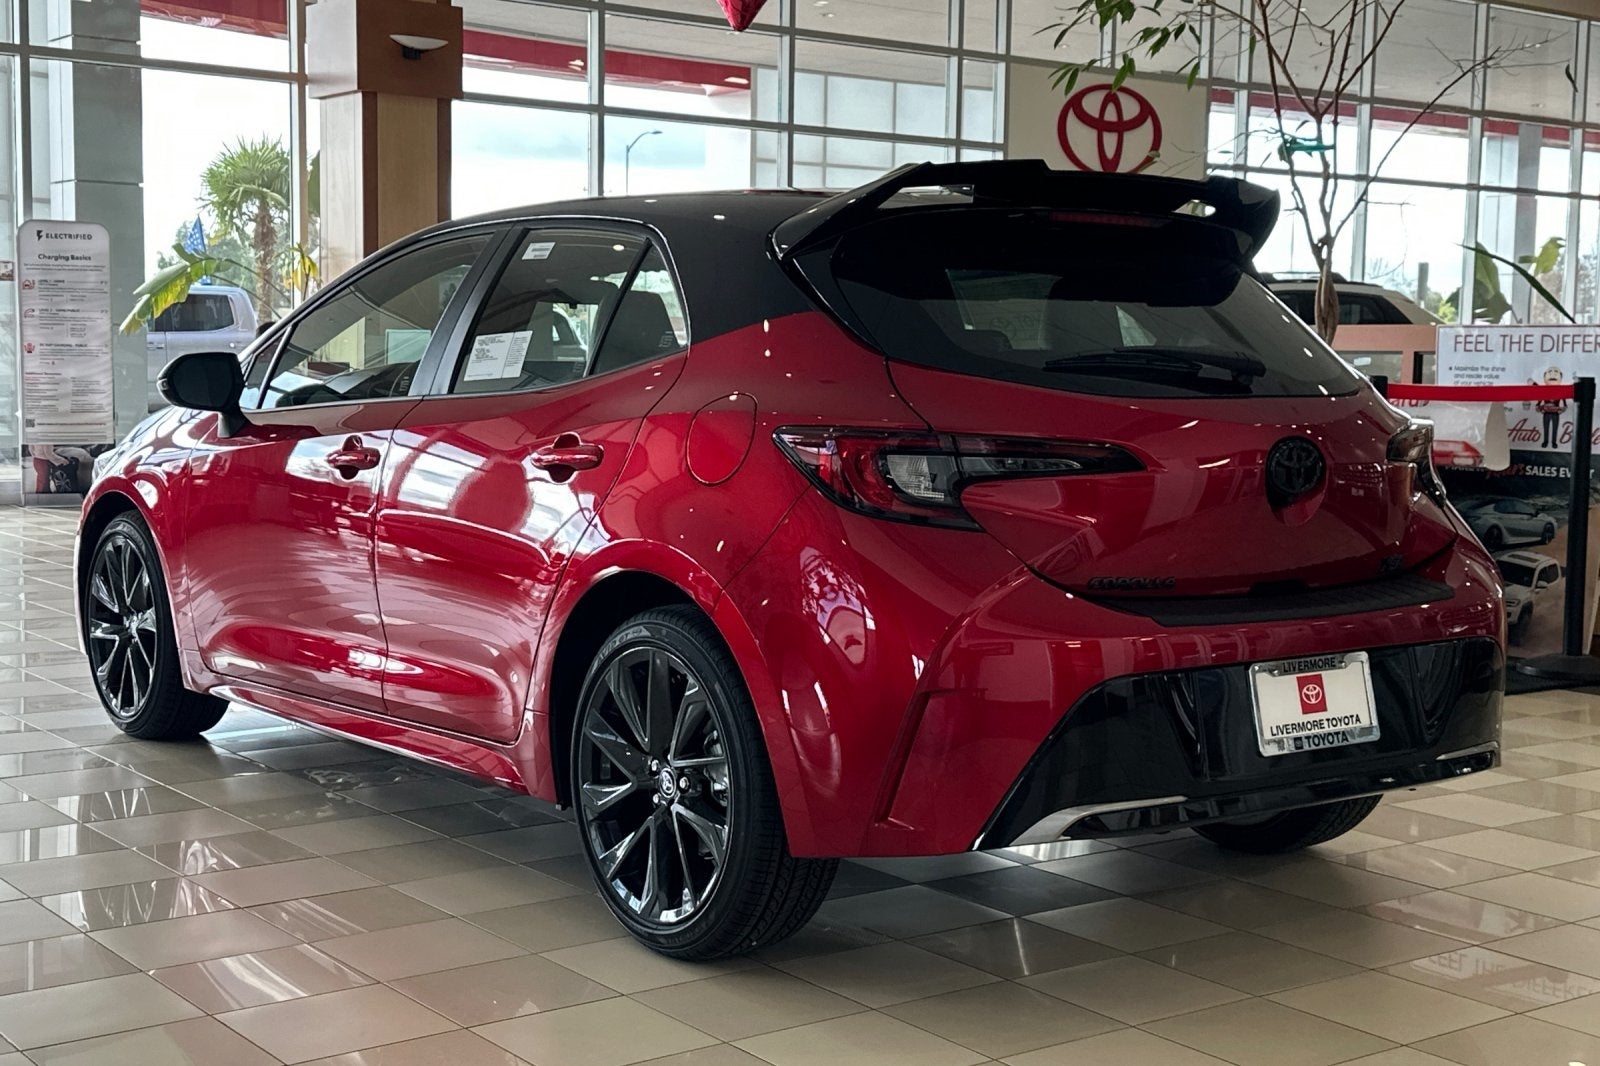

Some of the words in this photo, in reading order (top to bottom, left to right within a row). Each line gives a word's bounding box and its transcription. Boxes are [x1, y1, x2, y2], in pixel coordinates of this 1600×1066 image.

[45, 232, 93, 240] ELECTRIFIED
[38, 253, 70, 262] Charging
[1453, 334, 1493, 353] FEEL
[1500, 334, 1534, 353] THE
[1507, 418, 1541, 443] Auto
[1525, 465, 1557, 477] SALES
[1282, 656, 1337, 673] LIVERMORE
[1270, 718, 1325, 737] LIVERMORE
[1326, 714, 1362, 730] TOYOTA
[1305, 731, 1349, 749] TOYOTA
